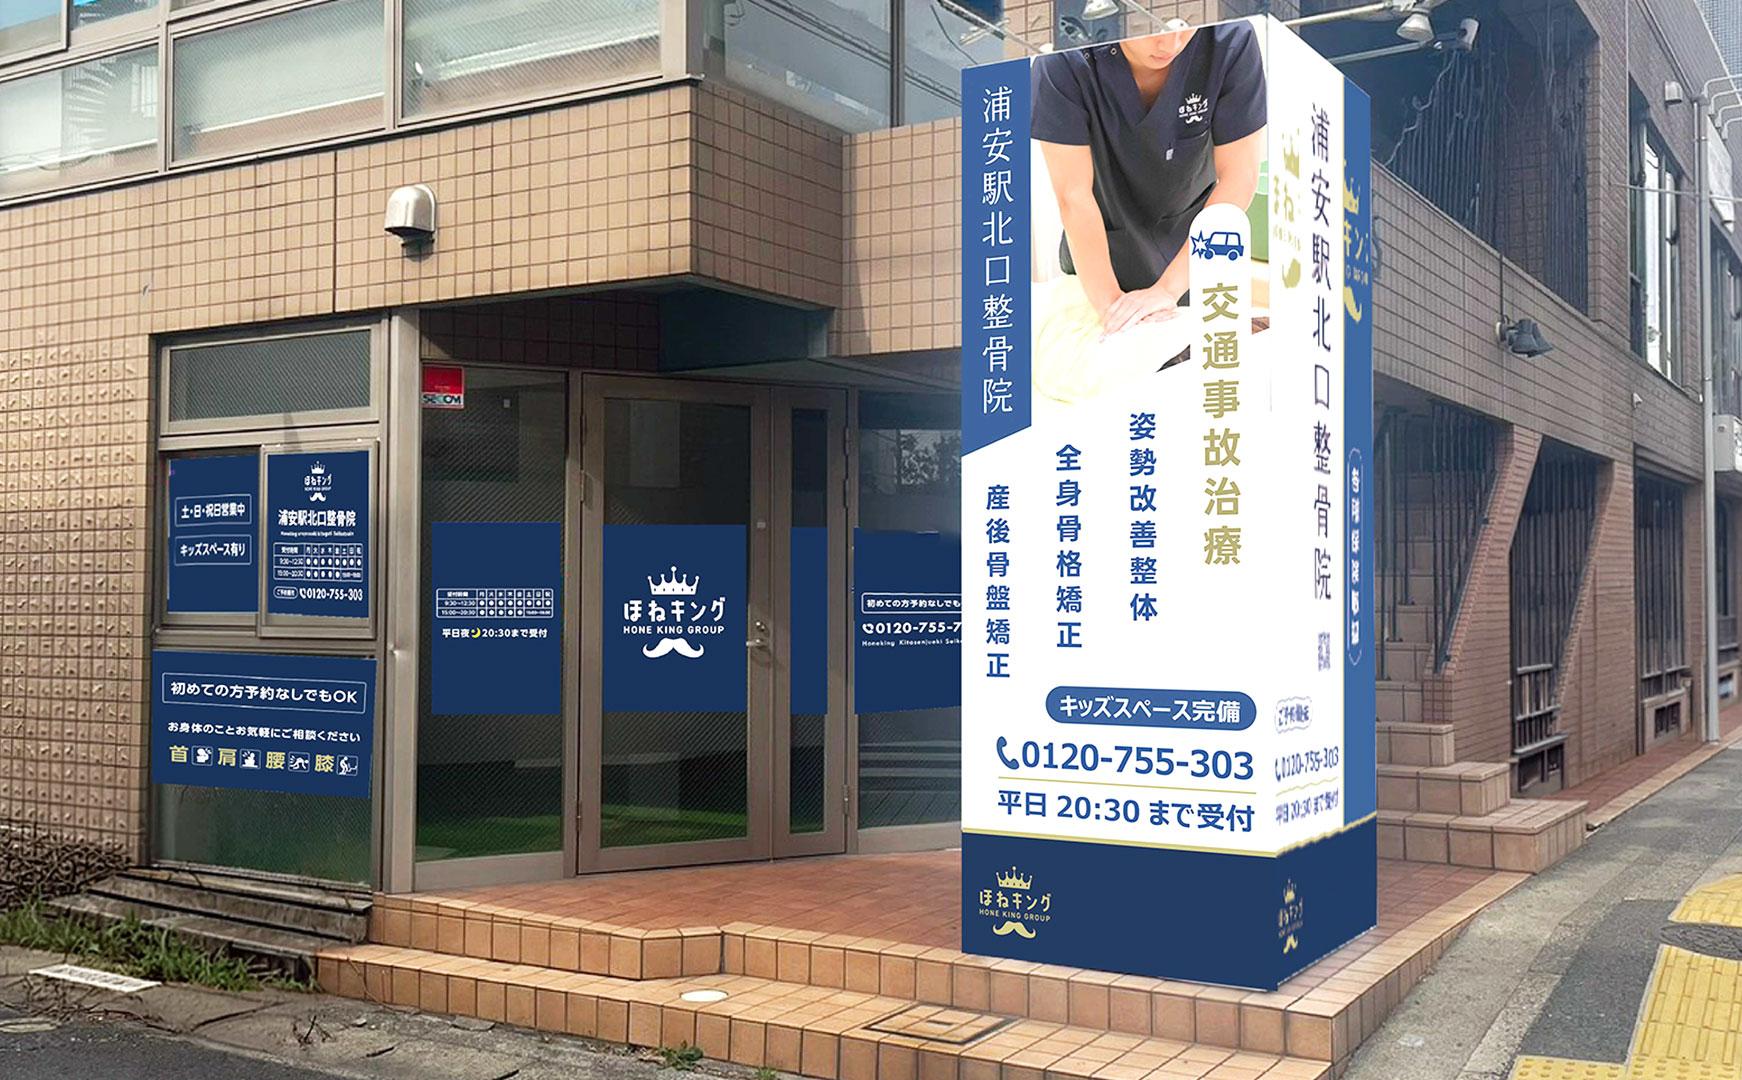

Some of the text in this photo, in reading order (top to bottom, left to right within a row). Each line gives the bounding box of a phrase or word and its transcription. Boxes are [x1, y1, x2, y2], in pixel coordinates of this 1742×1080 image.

[981, 86, 1014, 414] 浦安駅北口整骨院
[1311, 101, 1332, 600] 浦安駅北口整骨院
[1202, 282, 1242, 565] 交通事故治療
[181, 502, 245, 519] 土・日・祝日営業中
[278, 509, 356, 527] 浦安駅北口整骨院
[1129, 412, 1158, 621] 姿勢改善整体
[180, 542, 245, 557] キッズスペース有り
[1056, 444, 1082, 648] 全身骨格矯正
[307, 588, 363, 600] 0120-755-303
[986, 484, 1010, 678] 産後骨盤矯正
[624, 597, 726, 622] ほねキング
[623, 626, 725, 634] HONE KING GROUP
[170, 681, 358, 704] 初めての方予約なしでもOK
[1059, 695, 1241, 724] キッズスペース完備
[167, 722, 361, 743] お身体のことお気軽にご相談ください
[169, 745, 334, 773] 首 肩 腰 膝
[1021, 741, 1254, 780] 0120-755-303
[998, 789, 1255, 833] 平日 20:30 まで受付
[979, 889, 1052, 912] ほねキング
[979, 908, 1051, 922] HONE KING GROUP
